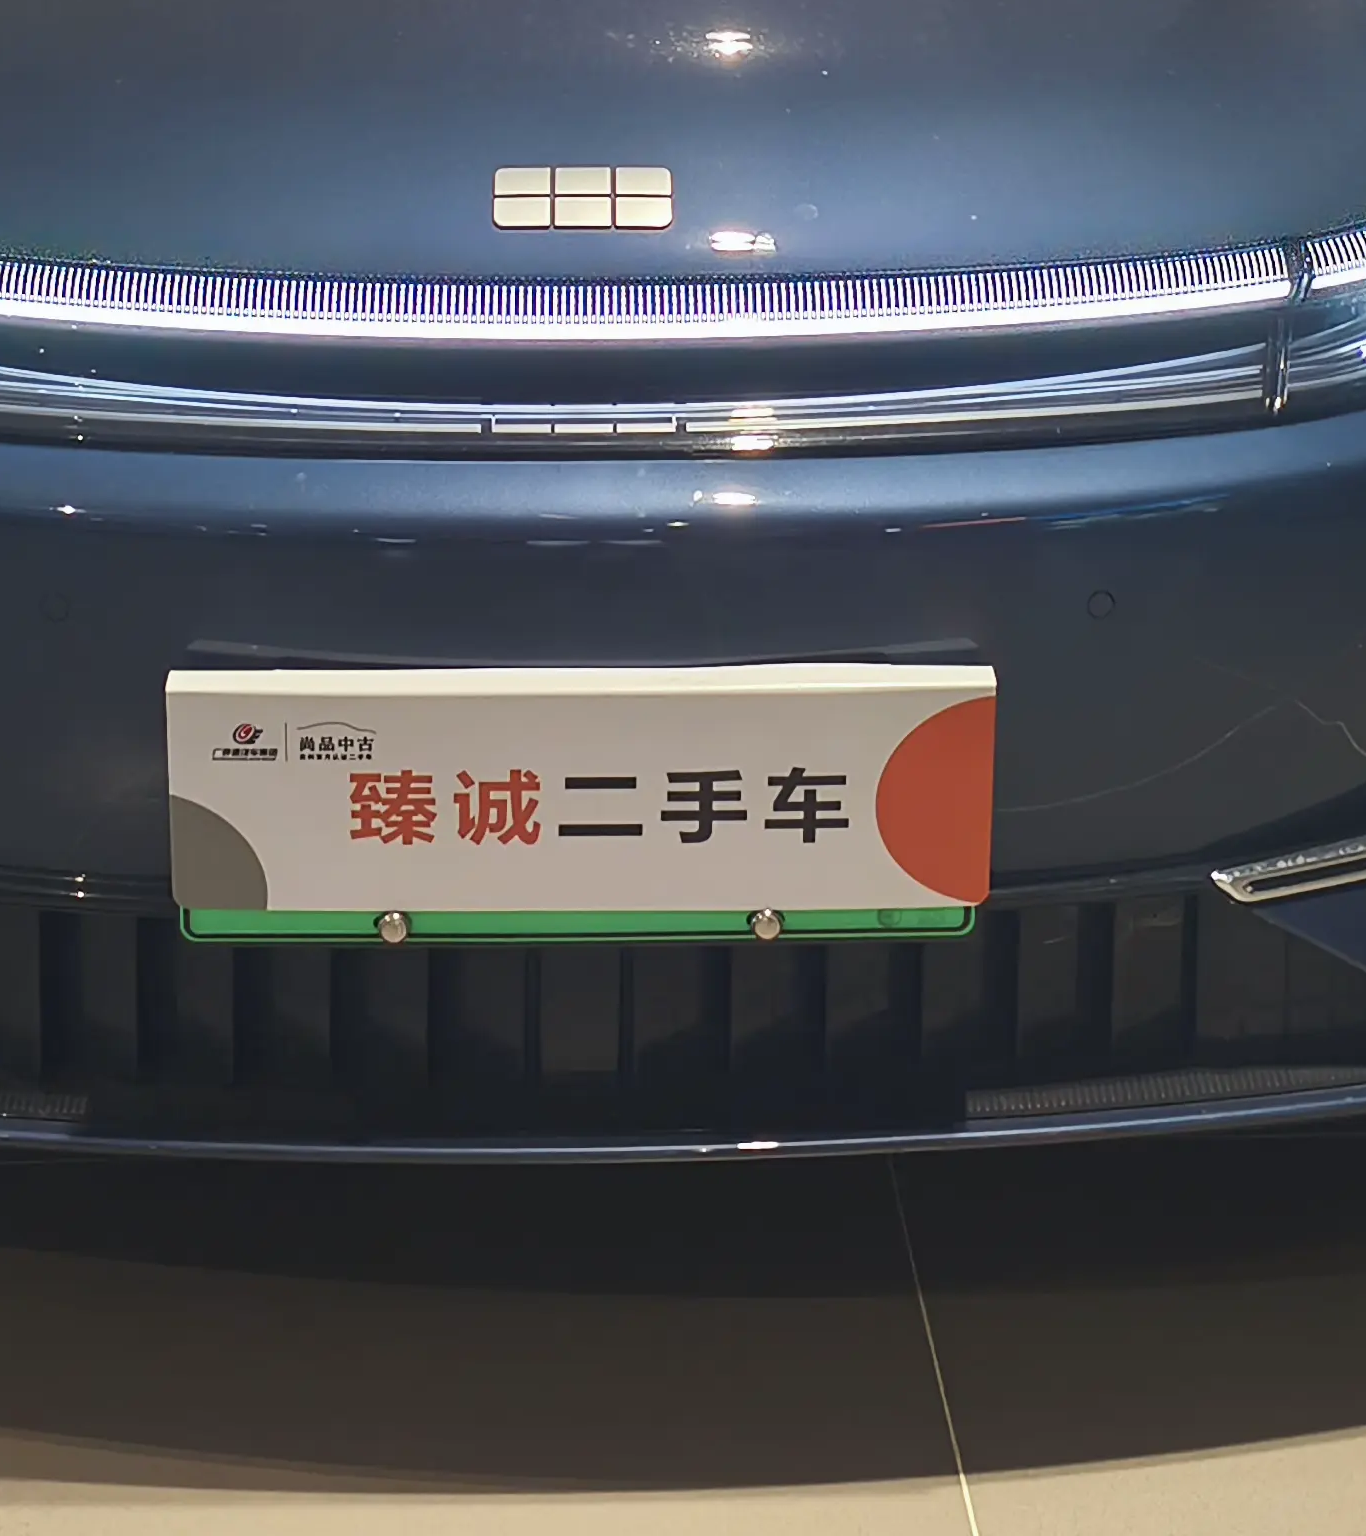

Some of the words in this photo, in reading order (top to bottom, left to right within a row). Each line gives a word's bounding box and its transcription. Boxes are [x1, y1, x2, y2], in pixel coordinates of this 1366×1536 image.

[299, 736, 374, 752] 尚品中古
[348, 766, 850, 847] 臻诚二手车
